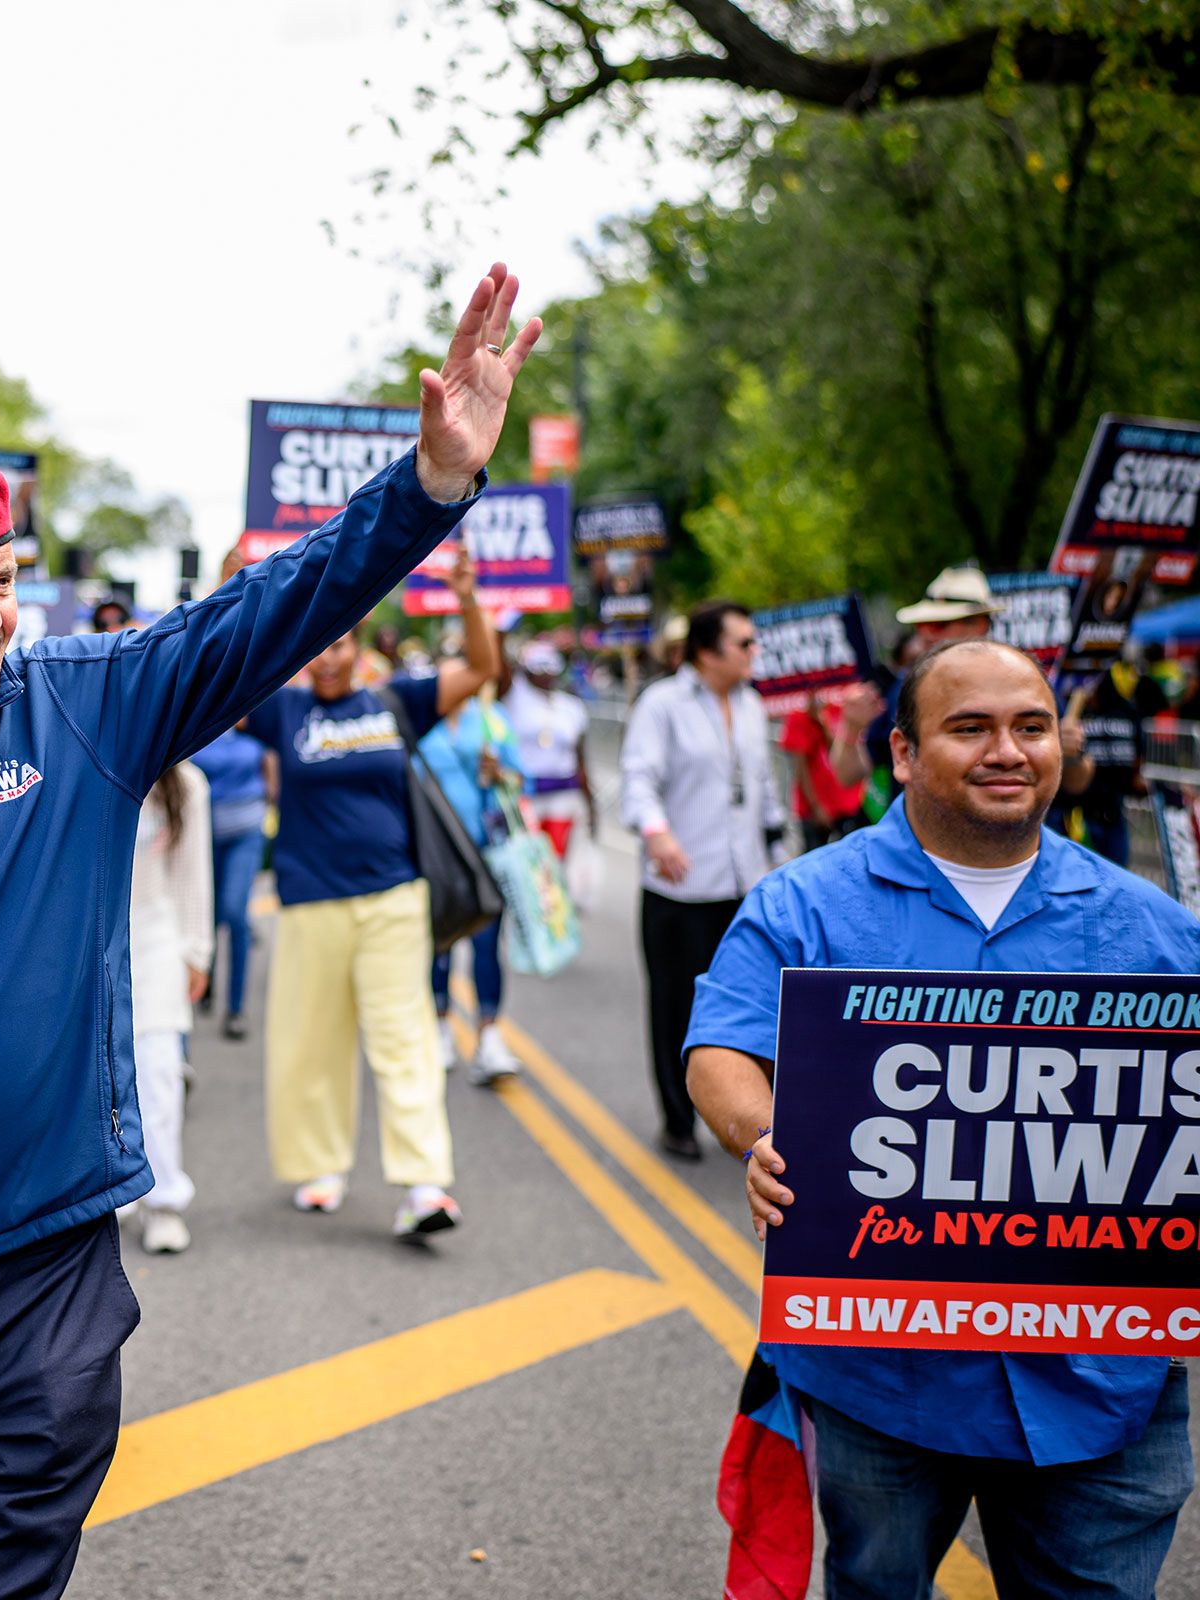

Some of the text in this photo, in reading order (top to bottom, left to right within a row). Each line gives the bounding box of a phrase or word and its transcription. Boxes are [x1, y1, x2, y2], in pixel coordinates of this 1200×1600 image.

[7, 774, 39, 799] MAYOR
[843, 984, 1004, 1024] FIGHTING
[1011, 990, 1079, 1026] FOR
[848, 1116, 1200, 1206] SLIWA
[848, 1204, 1200, 1259] for NYC MAYO
